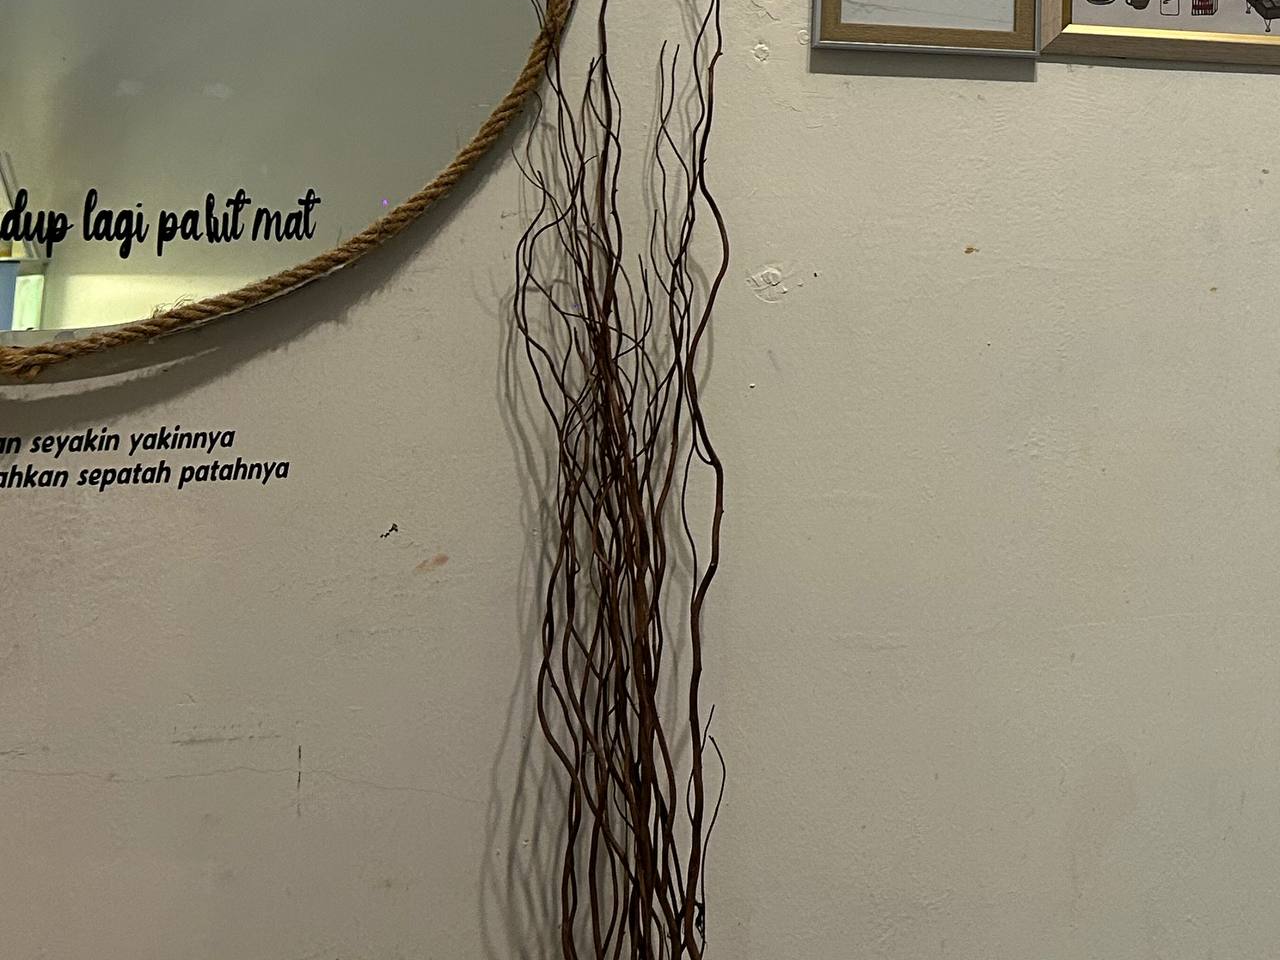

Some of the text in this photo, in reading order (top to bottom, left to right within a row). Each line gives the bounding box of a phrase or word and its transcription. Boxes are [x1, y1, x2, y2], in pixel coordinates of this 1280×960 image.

[83, 188, 149, 259] lagi
[252, 189, 321, 242] mat
[29, 427, 120, 459] seyakin
[128, 425, 236, 456] yakinnya
[76, 460, 171, 492] sepatah
[178, 456, 290, 489] patahnya
